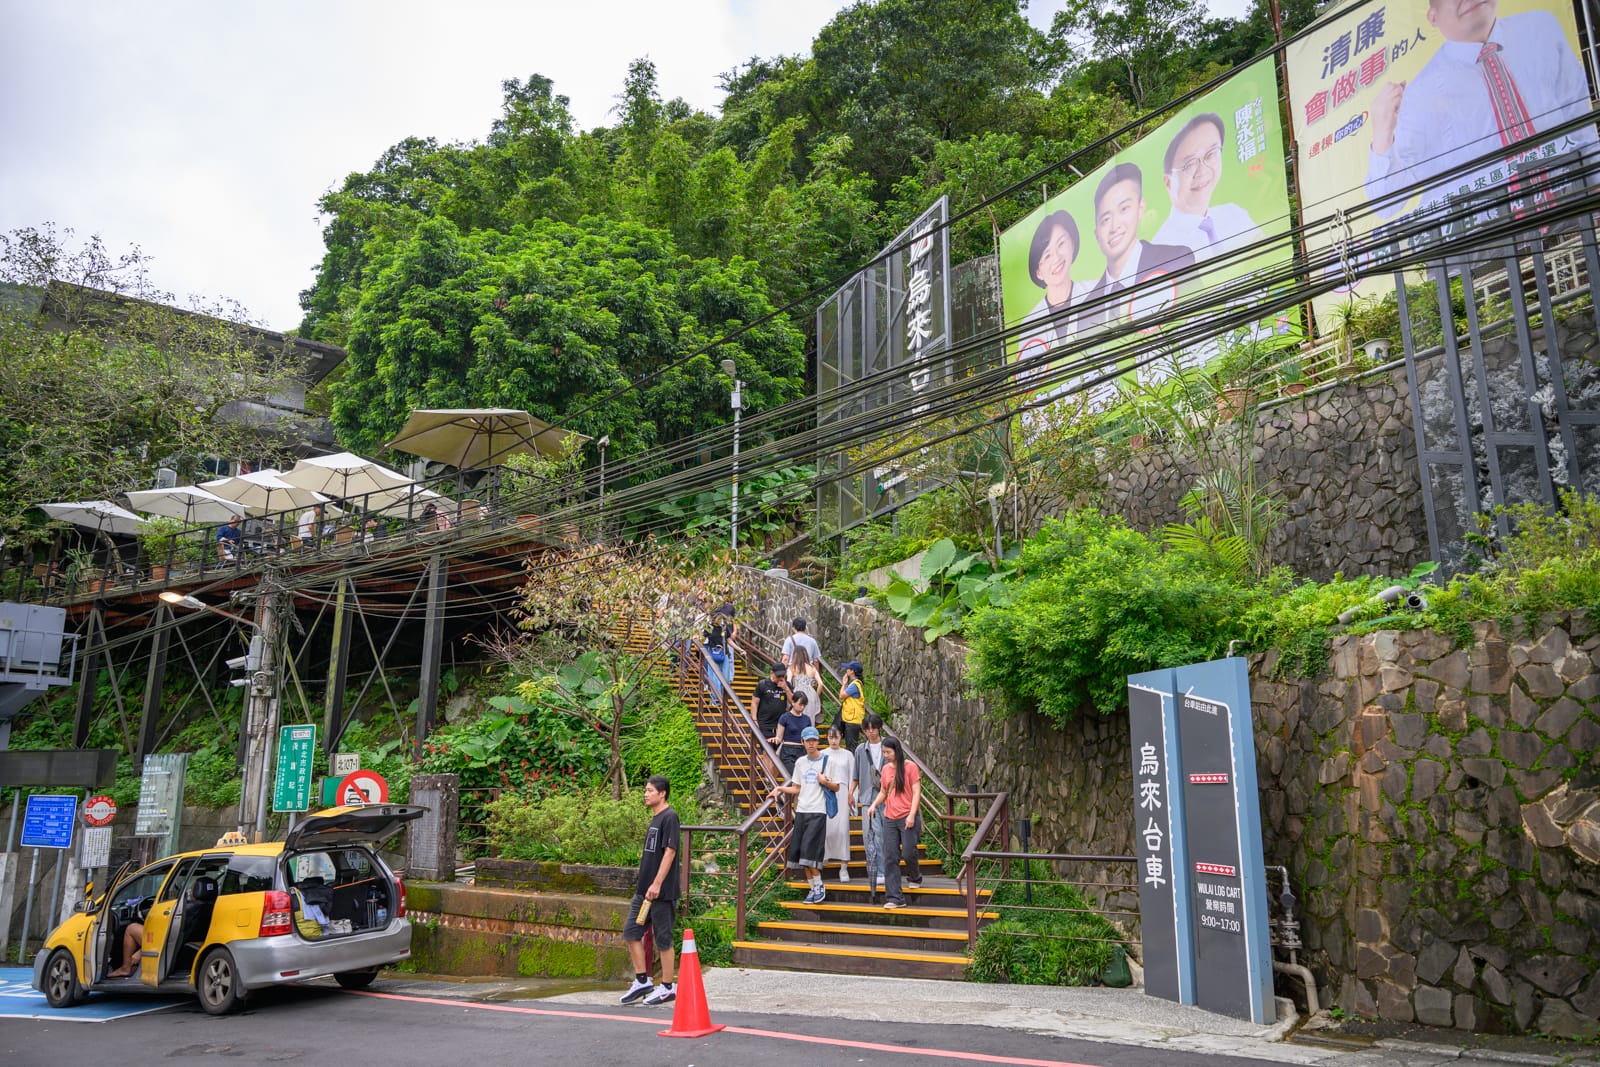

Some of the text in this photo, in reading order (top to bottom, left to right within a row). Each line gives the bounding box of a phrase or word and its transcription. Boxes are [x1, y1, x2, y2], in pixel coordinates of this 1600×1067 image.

[1321, 6, 1386, 79] 清廉
[1235, 102, 1257, 164] 陳永福
[1138, 741, 1166, 889] 烏來台車
[1198, 883, 1240, 898] WULAI LOG CART
[1206, 899, 1235, 914] 營業時間
